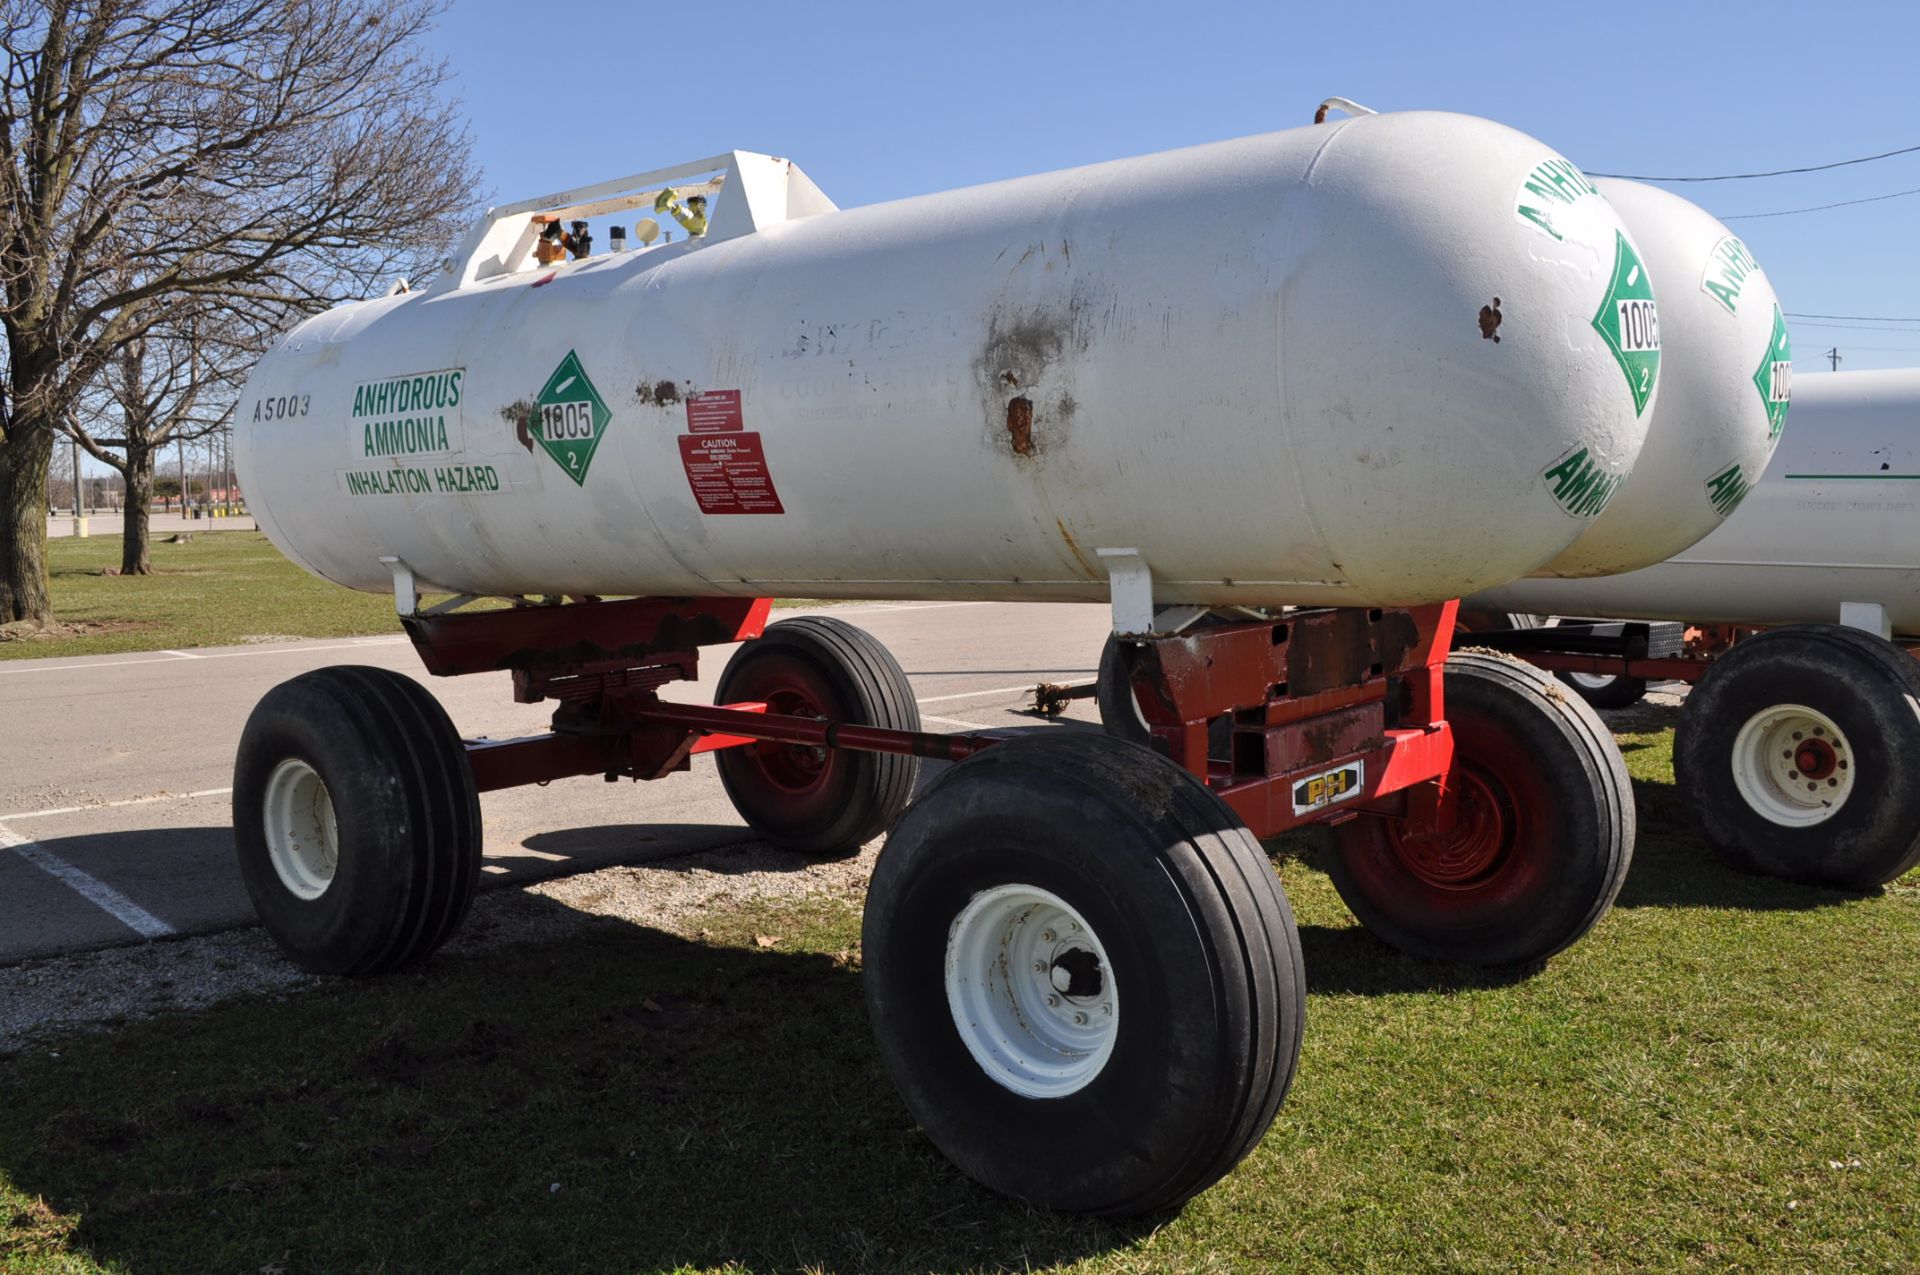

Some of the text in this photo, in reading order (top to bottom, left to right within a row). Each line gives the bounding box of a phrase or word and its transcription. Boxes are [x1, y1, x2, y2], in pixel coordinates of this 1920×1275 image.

[1620, 301, 1659, 349] 1005
[352, 371, 462, 418] ANHYDROUS
[1639, 367, 1650, 393] 2
[253, 394, 311, 423] A5003
[543, 403, 591, 439] 1005
[364, 415, 450, 457] AMMONIA
[701, 438, 737, 449] CAUTION
[567, 451, 579, 469] 2
[345, 465, 499, 496] INHALATION HAZARD
